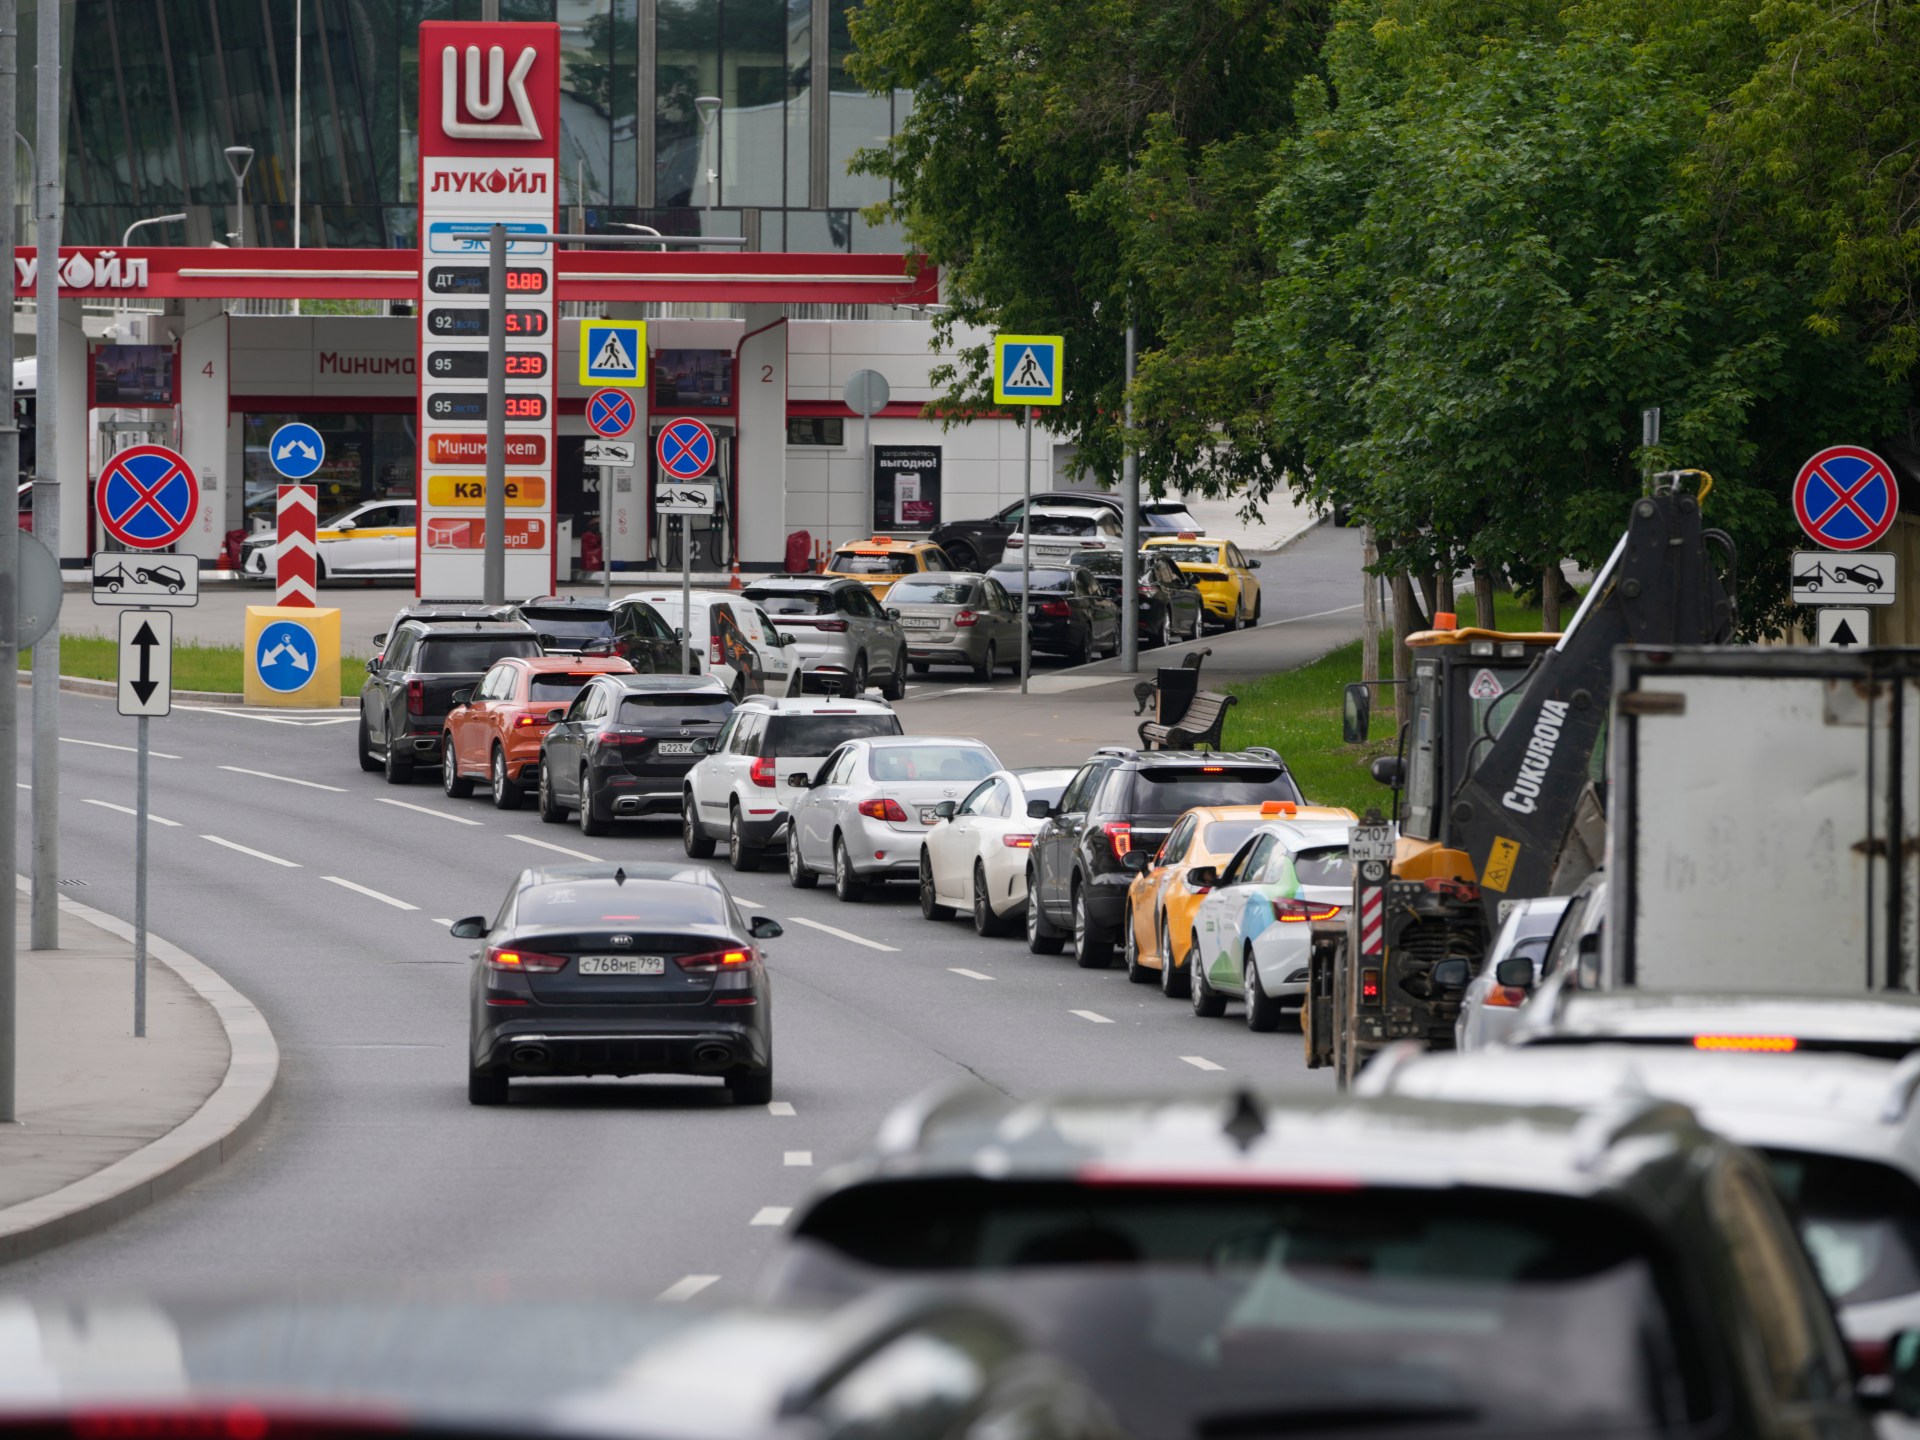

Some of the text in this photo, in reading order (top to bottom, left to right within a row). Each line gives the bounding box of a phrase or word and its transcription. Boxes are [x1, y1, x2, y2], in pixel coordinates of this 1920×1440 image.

[431, 167, 547, 193] ЛУКОЙЛ
[435, 274, 454, 287] ДТ
[435, 316, 452, 328] 92
[202, 361, 214, 378] 4
[435, 359, 452, 370] 95
[761, 365, 773, 382] 2
[435, 401, 452, 412] 95
[437, 440, 537, 455] Минимкет
[880, 458, 937, 469] выгодно!
[454, 483, 519, 498] кае
[1354, 827, 1389, 842] 2107
[1352, 844, 1392, 858] МН 77
[1365, 864, 1381, 876] 40
[584, 957, 660, 973] С768МЕ 799
